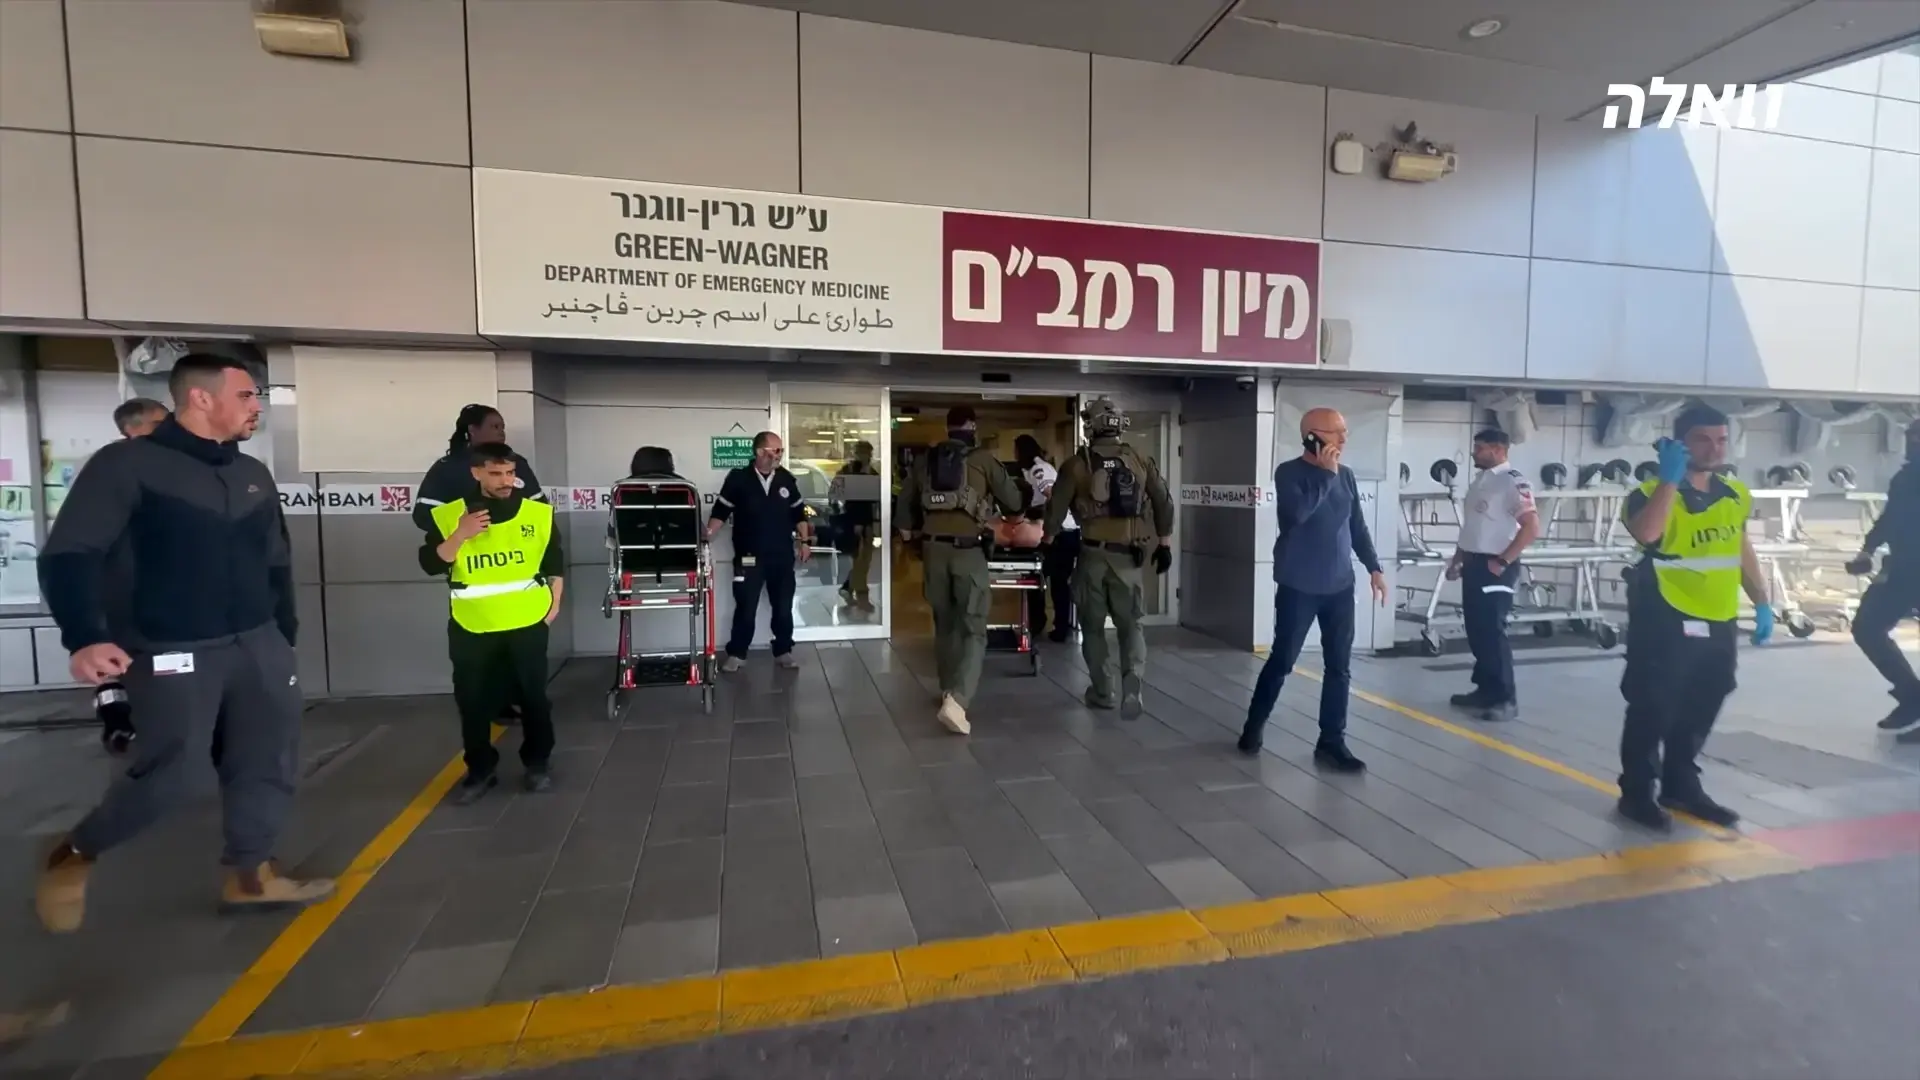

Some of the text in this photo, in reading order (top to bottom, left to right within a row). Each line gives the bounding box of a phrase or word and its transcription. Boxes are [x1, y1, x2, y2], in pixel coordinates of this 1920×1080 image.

[611, 192, 755, 230] גרין-ווגנר
[614, 232, 829, 270] GREEN-WAGNER
[544, 264, 890, 301] DEPARTMENT OF EMERGENCY MEDICINE
[713, 301, 767, 329] اسم
[774, 303, 821, 331] على
[1201, 268, 1310, 353] מיון
[1211, 490, 1246, 502] RAMBAM
[466, 550, 525, 574] ביטחון
